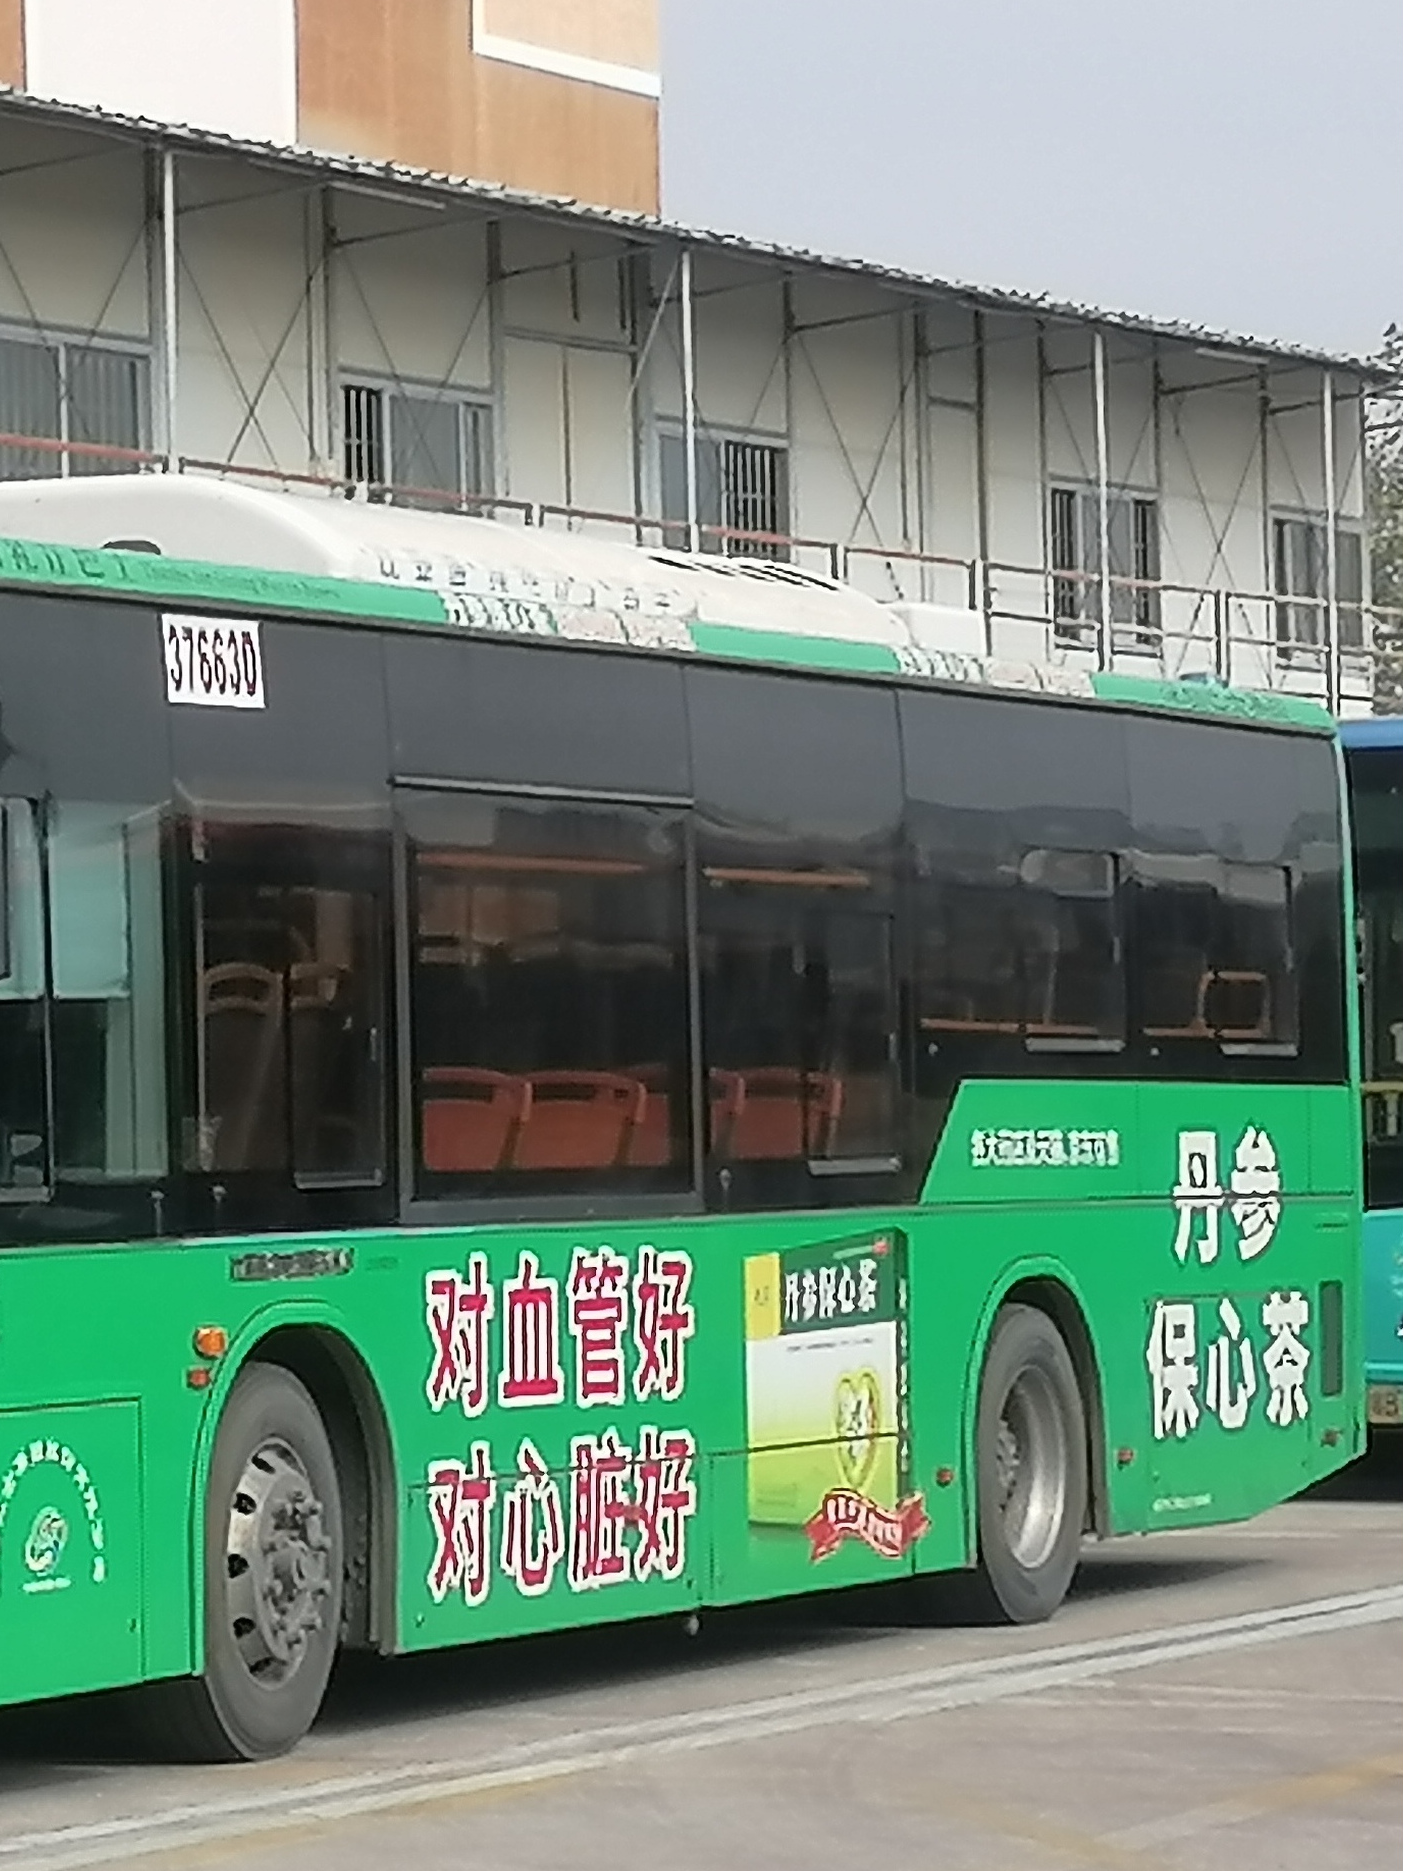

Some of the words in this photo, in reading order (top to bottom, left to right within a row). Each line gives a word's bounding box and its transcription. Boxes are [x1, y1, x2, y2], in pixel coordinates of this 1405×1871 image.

[1170, 1124, 1282, 1264] 丹参
[425, 1245, 696, 1418] 对血管好
[1146, 1290, 1311, 1441] 保心茶
[426, 1424, 697, 1605] 对心脏好
